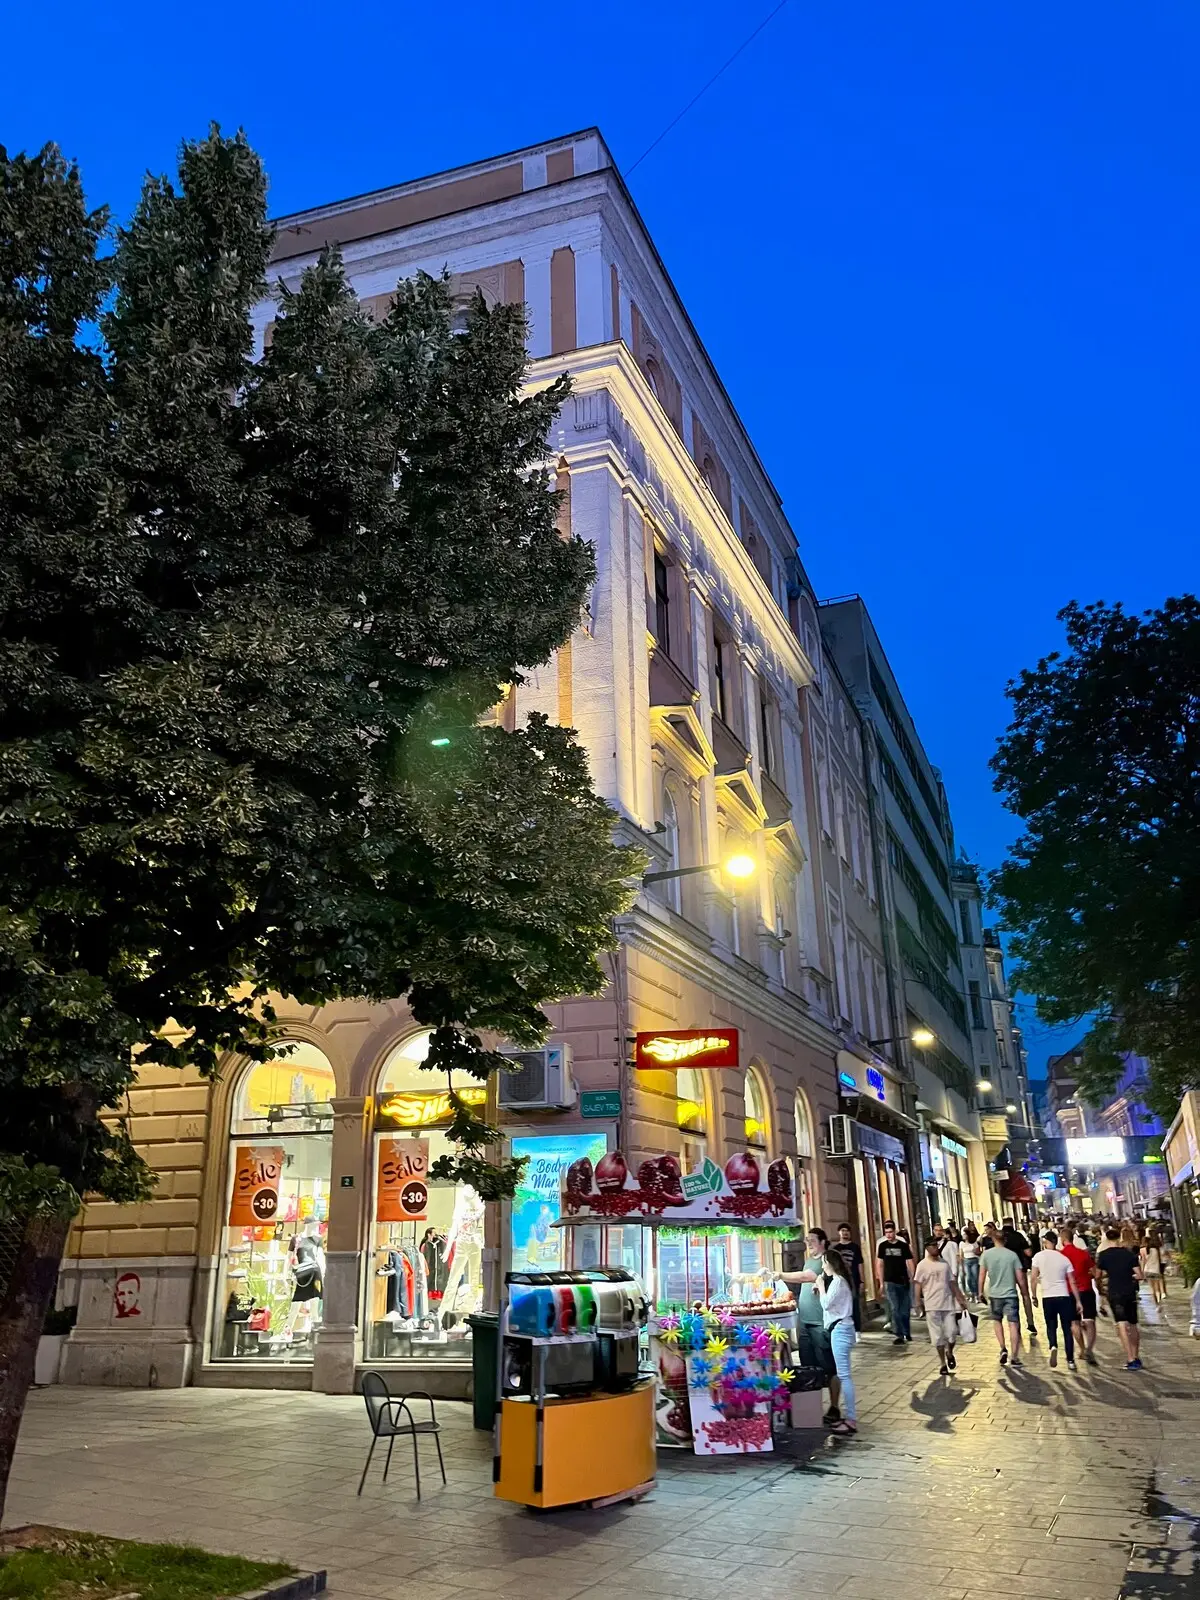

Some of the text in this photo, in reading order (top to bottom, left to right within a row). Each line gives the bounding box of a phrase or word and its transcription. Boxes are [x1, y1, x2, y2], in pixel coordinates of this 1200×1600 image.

[605, 1103, 621, 1111] TRG
[238, 1162, 277, 1190] Sale
[383, 1155, 424, 1185] Sale
